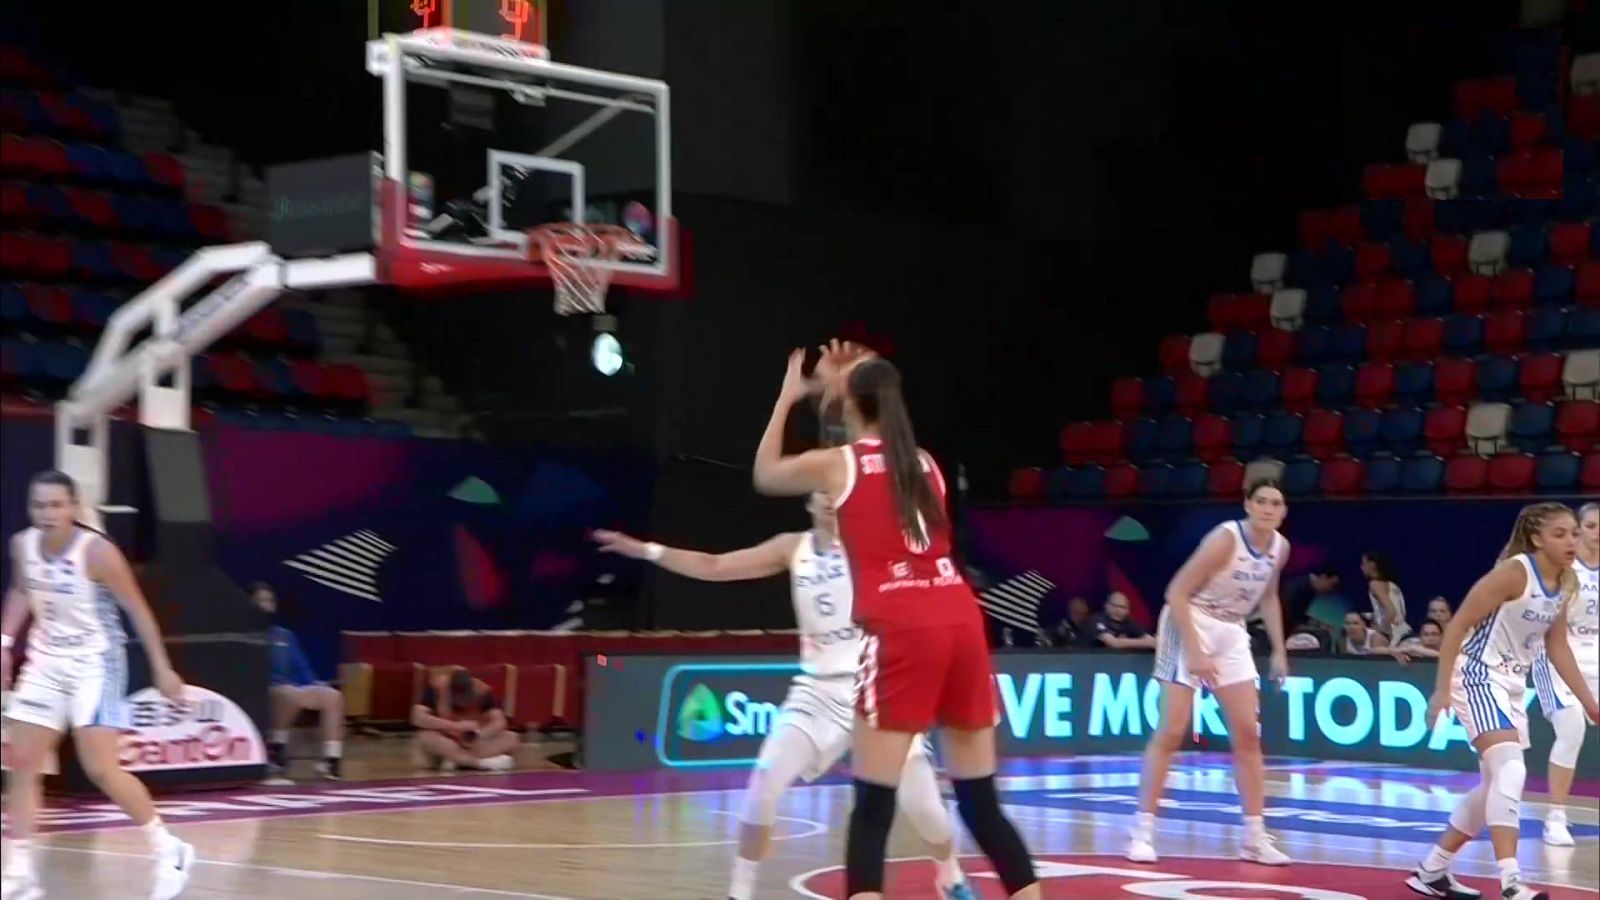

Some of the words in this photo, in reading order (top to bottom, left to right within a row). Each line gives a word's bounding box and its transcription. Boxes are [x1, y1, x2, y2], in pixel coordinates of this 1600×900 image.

[1088, 672, 1262, 737] MR
[1280, 676, 1537, 751] TODA
[36, 783, 592, 824] SRAEL
